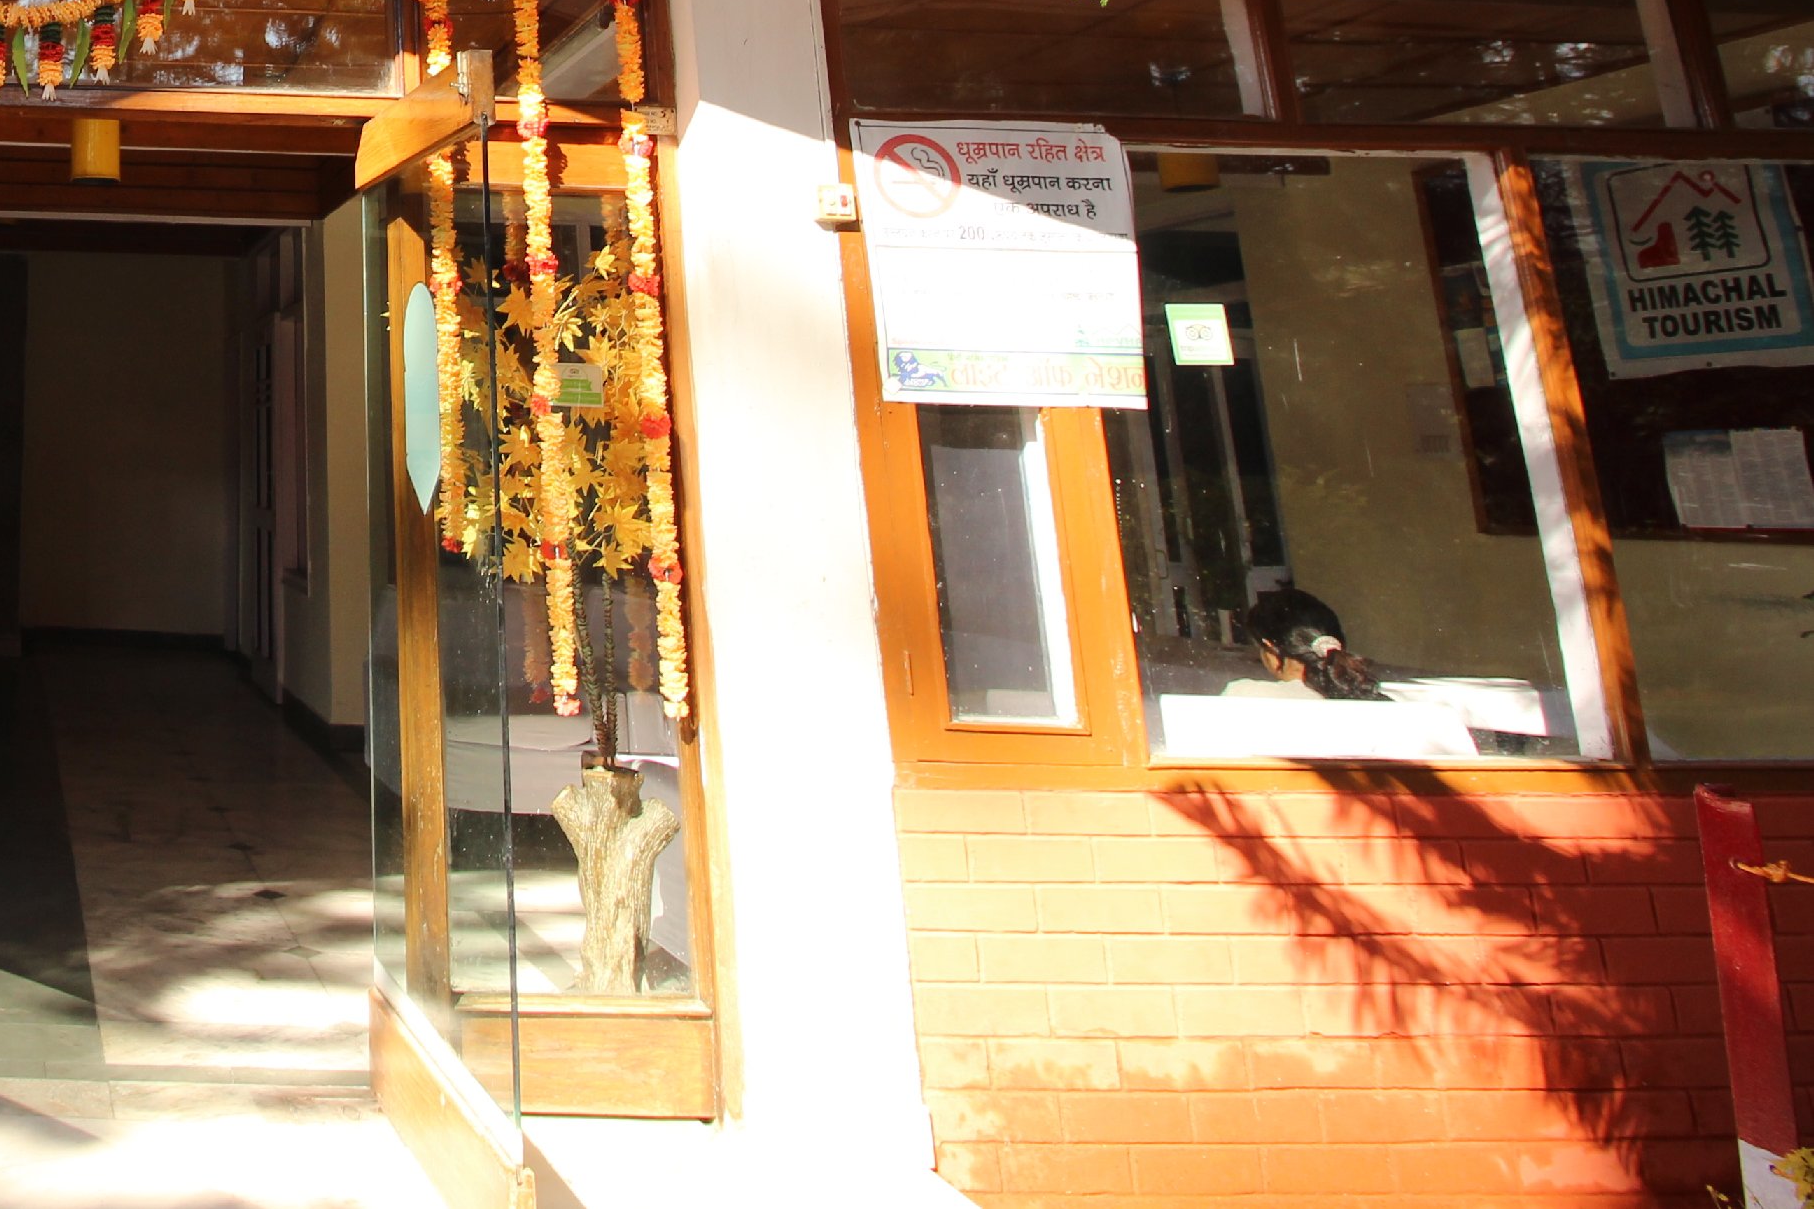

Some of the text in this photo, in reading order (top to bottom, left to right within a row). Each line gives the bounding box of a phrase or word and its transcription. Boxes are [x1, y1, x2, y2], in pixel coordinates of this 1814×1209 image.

[956, 137, 1107, 165] धूम्रपान रहित क्षेत्र
[966, 167, 1113, 194] यहाँ धूम्रपान करना
[1026, 202, 1080, 218] अपराध
[1081, 198, 1097, 220] है
[958, 225, 986, 241] 200
[1627, 273, 1787, 312] HIMACHAL
[1642, 304, 1783, 339] TOURISM
